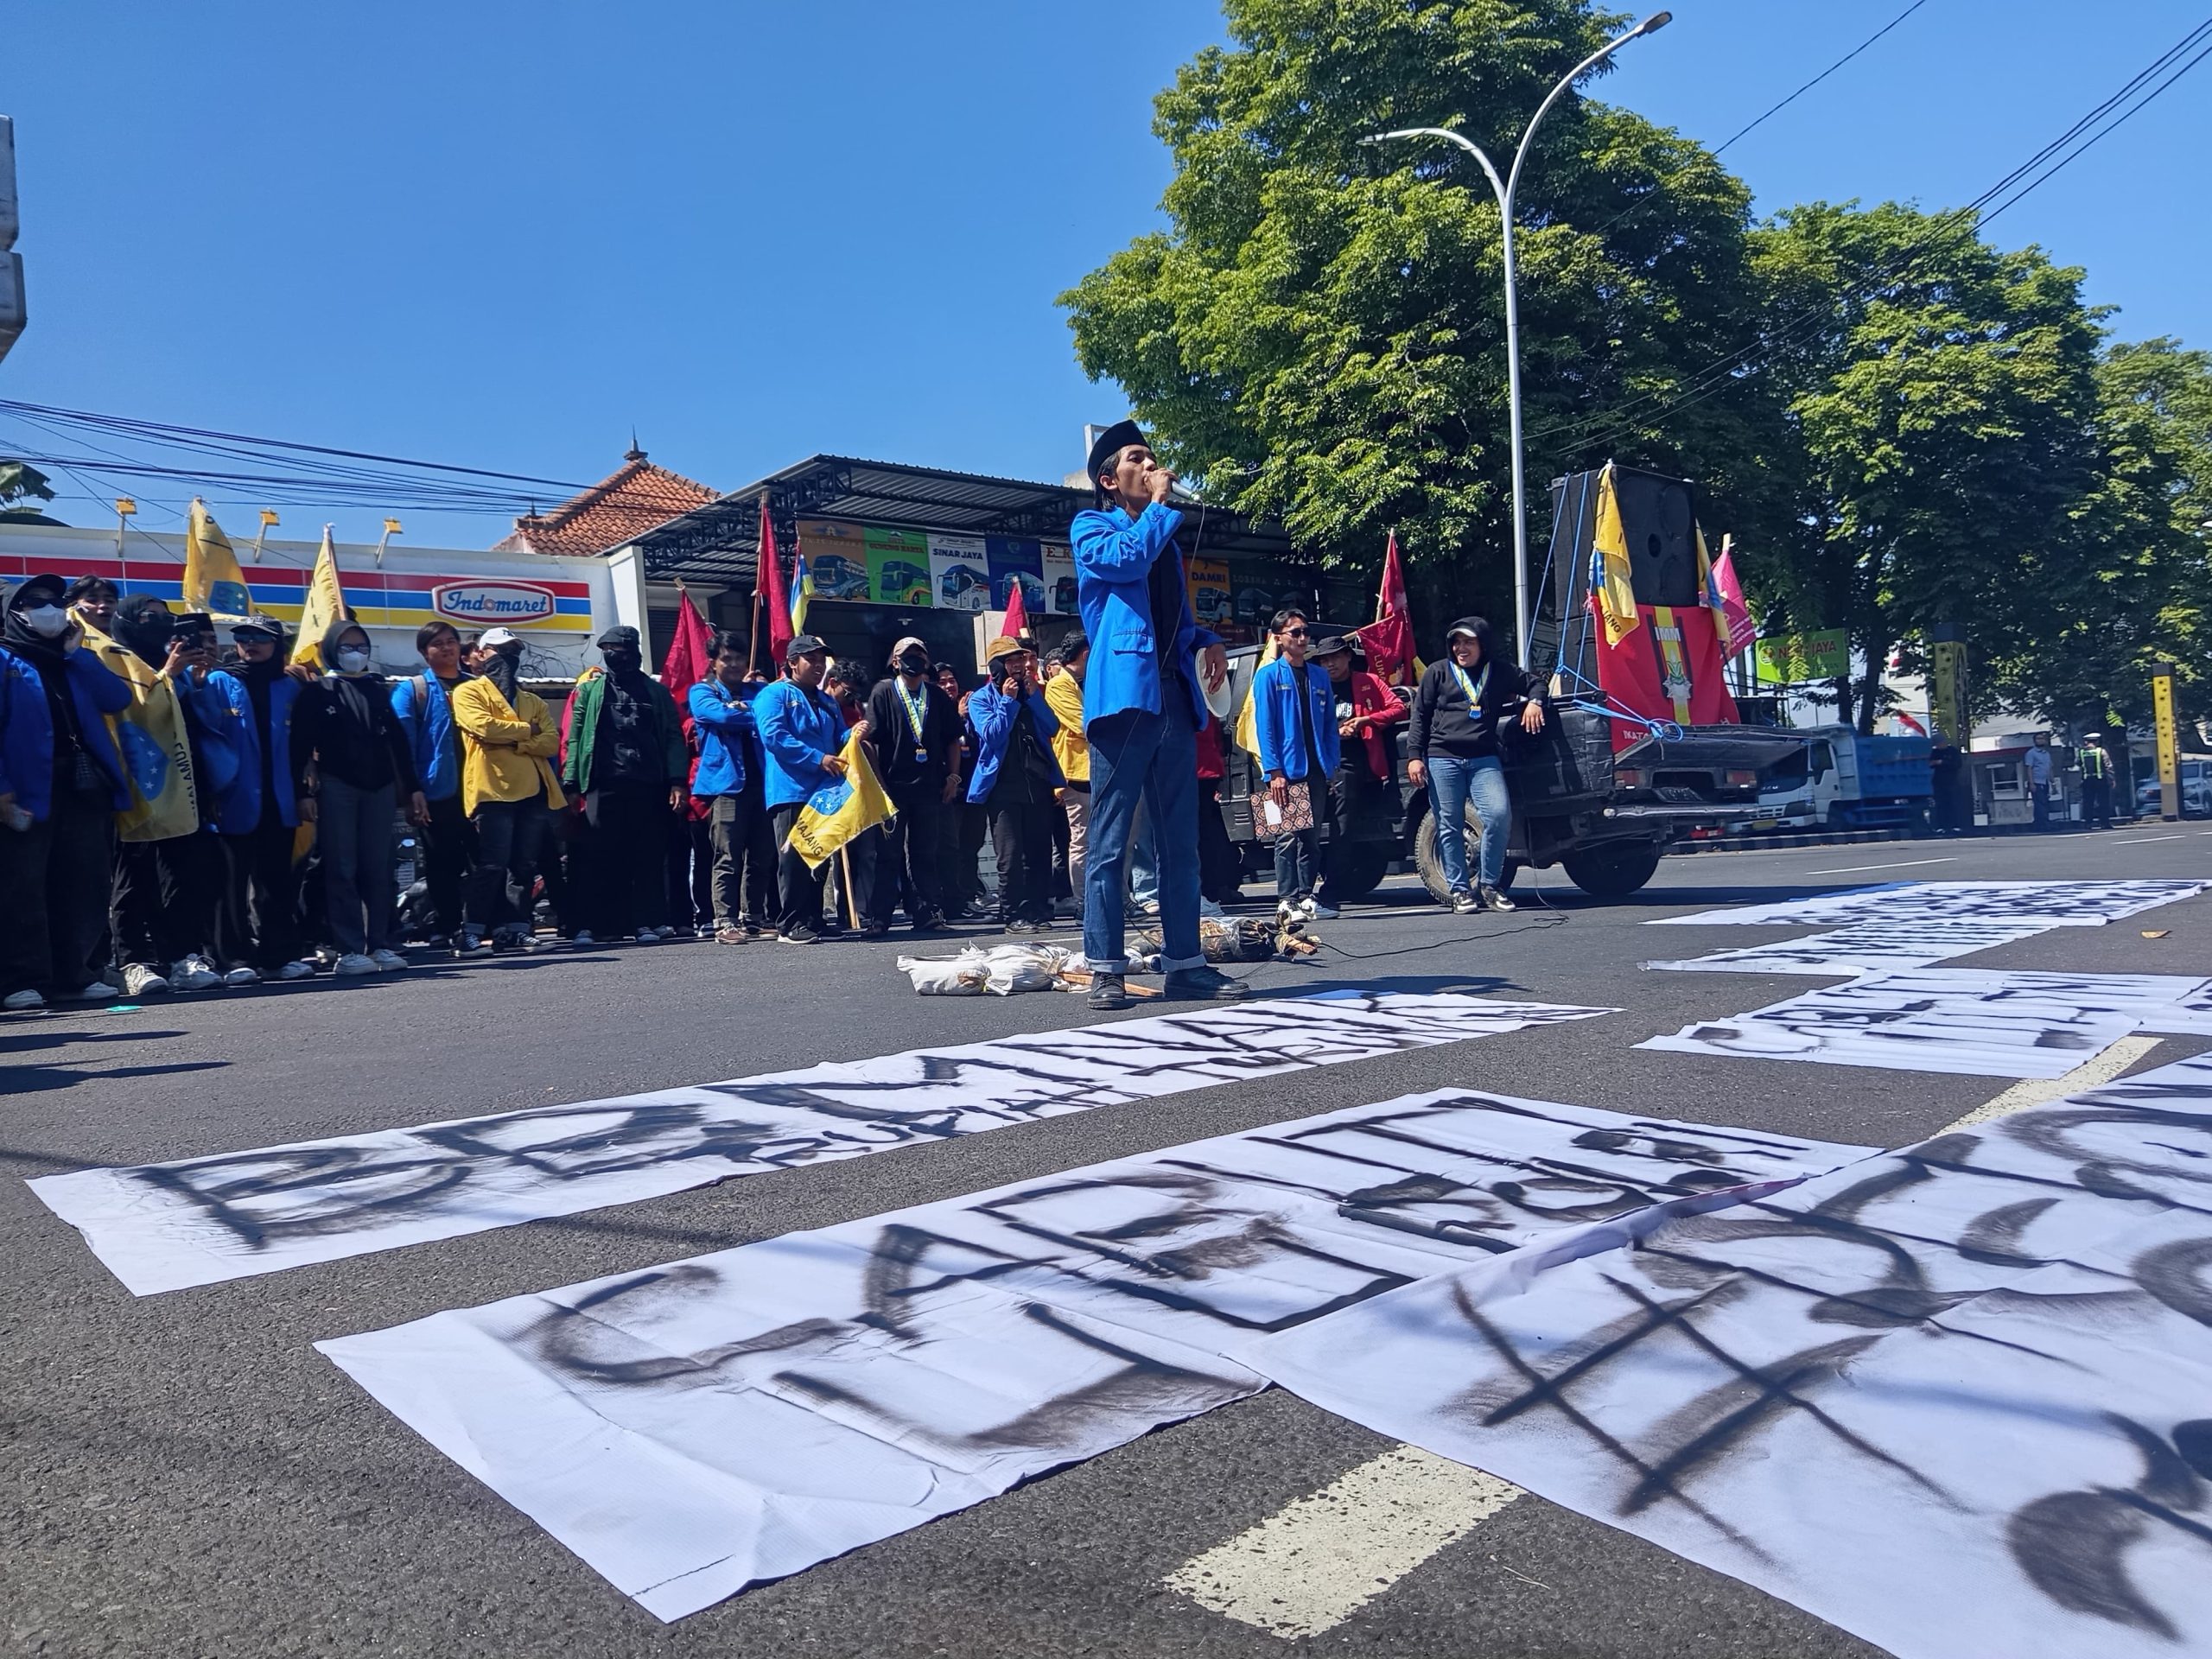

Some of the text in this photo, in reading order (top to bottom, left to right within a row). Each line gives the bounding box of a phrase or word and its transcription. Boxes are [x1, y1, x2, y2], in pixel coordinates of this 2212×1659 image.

[932, 548, 960, 558] SINAR
[961, 550, 983, 560] JAYA
[1192, 571, 1226, 583] DAMRI
[444, 590, 547, 613] Indomaret
[1654, 625, 1681, 642] IMM
